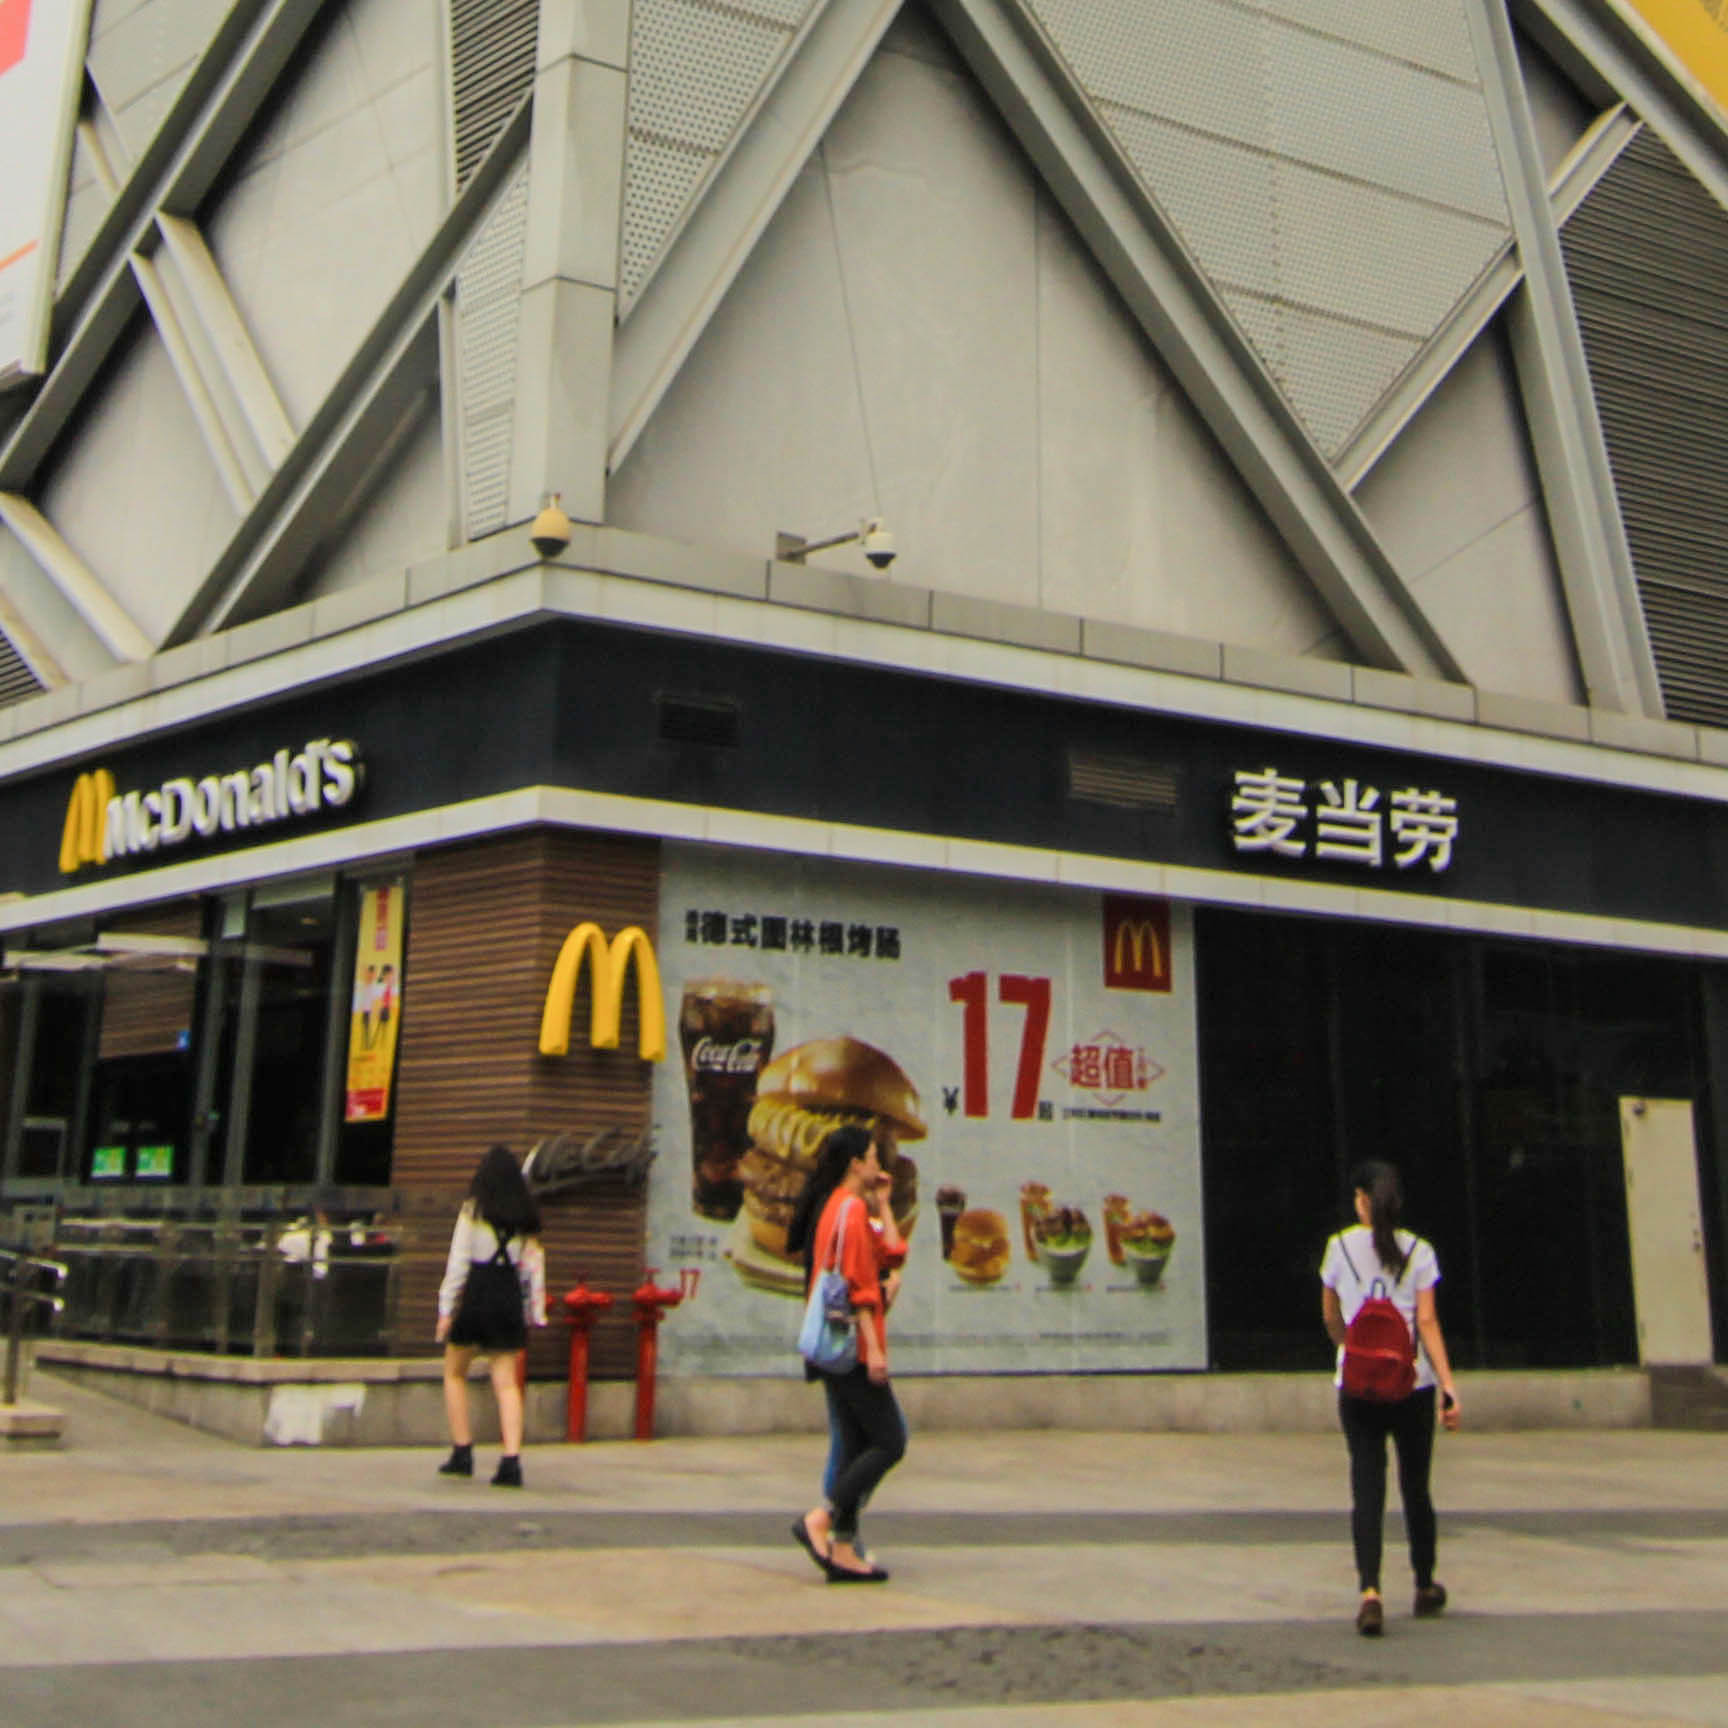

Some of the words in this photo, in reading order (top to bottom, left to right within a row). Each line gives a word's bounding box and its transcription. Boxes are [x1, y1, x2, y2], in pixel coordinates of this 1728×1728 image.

[104, 738, 358, 860] McDonald's
[1231, 768, 1459, 873] 麦当劳
